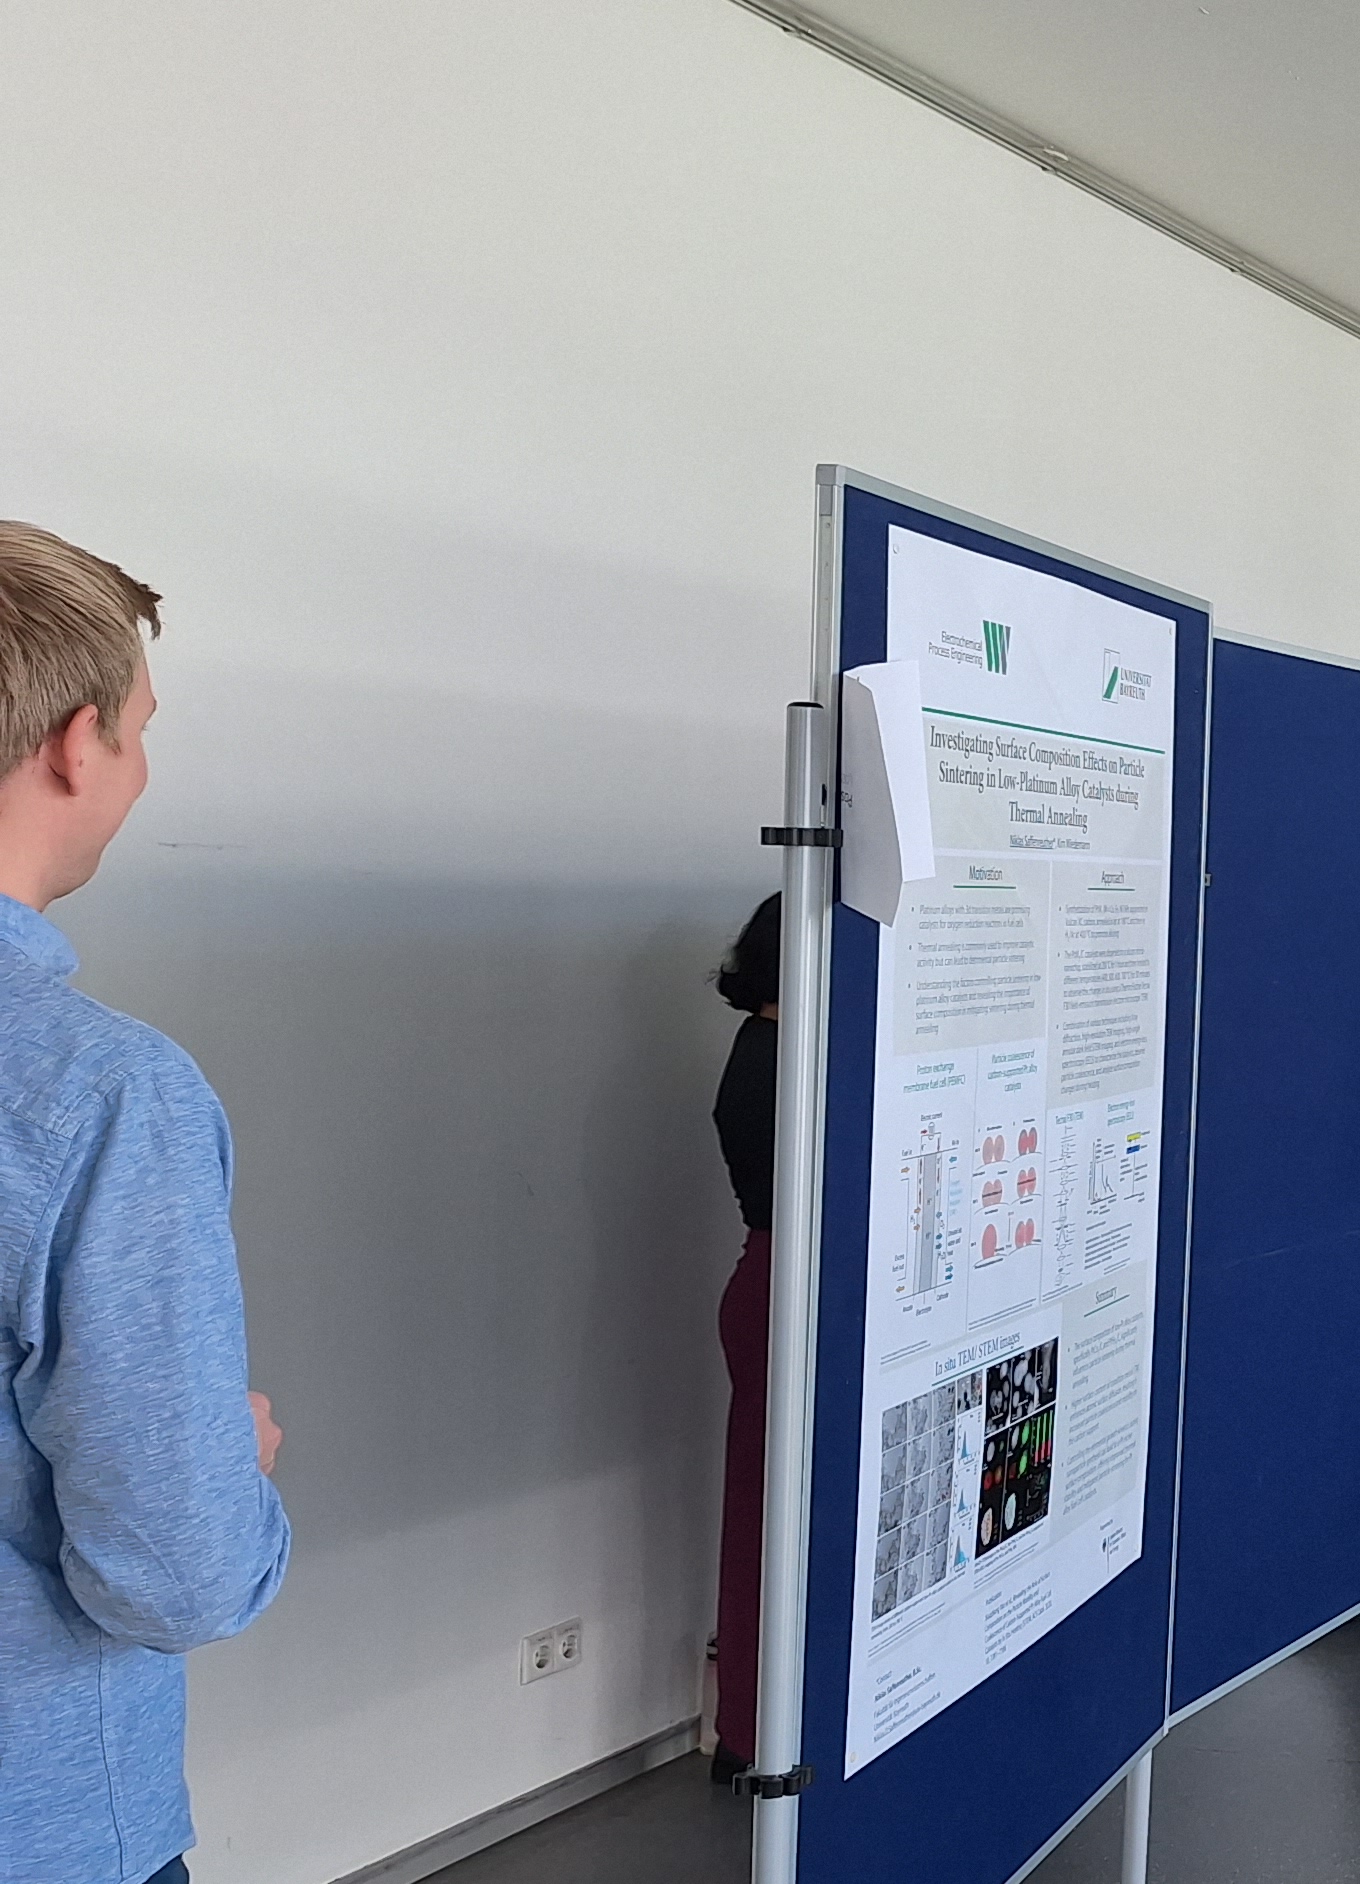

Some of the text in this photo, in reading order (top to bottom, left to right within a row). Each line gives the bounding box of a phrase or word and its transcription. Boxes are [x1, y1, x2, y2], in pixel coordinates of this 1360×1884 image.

[941, 631, 982, 652] Electrochemical
[928, 642, 983, 669] Process Engineering
[1120, 683, 1146, 701] BAYREUTH
[930, 725, 1145, 778] Investigating Surface Composition Effects on Particle
[939, 761, 1139, 810] Sintering in Low-Platinum Alloy Catalysts during
[1009, 801, 1088, 834] Thermal Annealing
[968, 865, 1002, 881] Motivation
[1101, 871, 1125, 886] Approach
[944, 1356, 956, 1372] situ
[978, 1336, 999, 1359] STEM
[999, 1332, 1021, 1350] images
